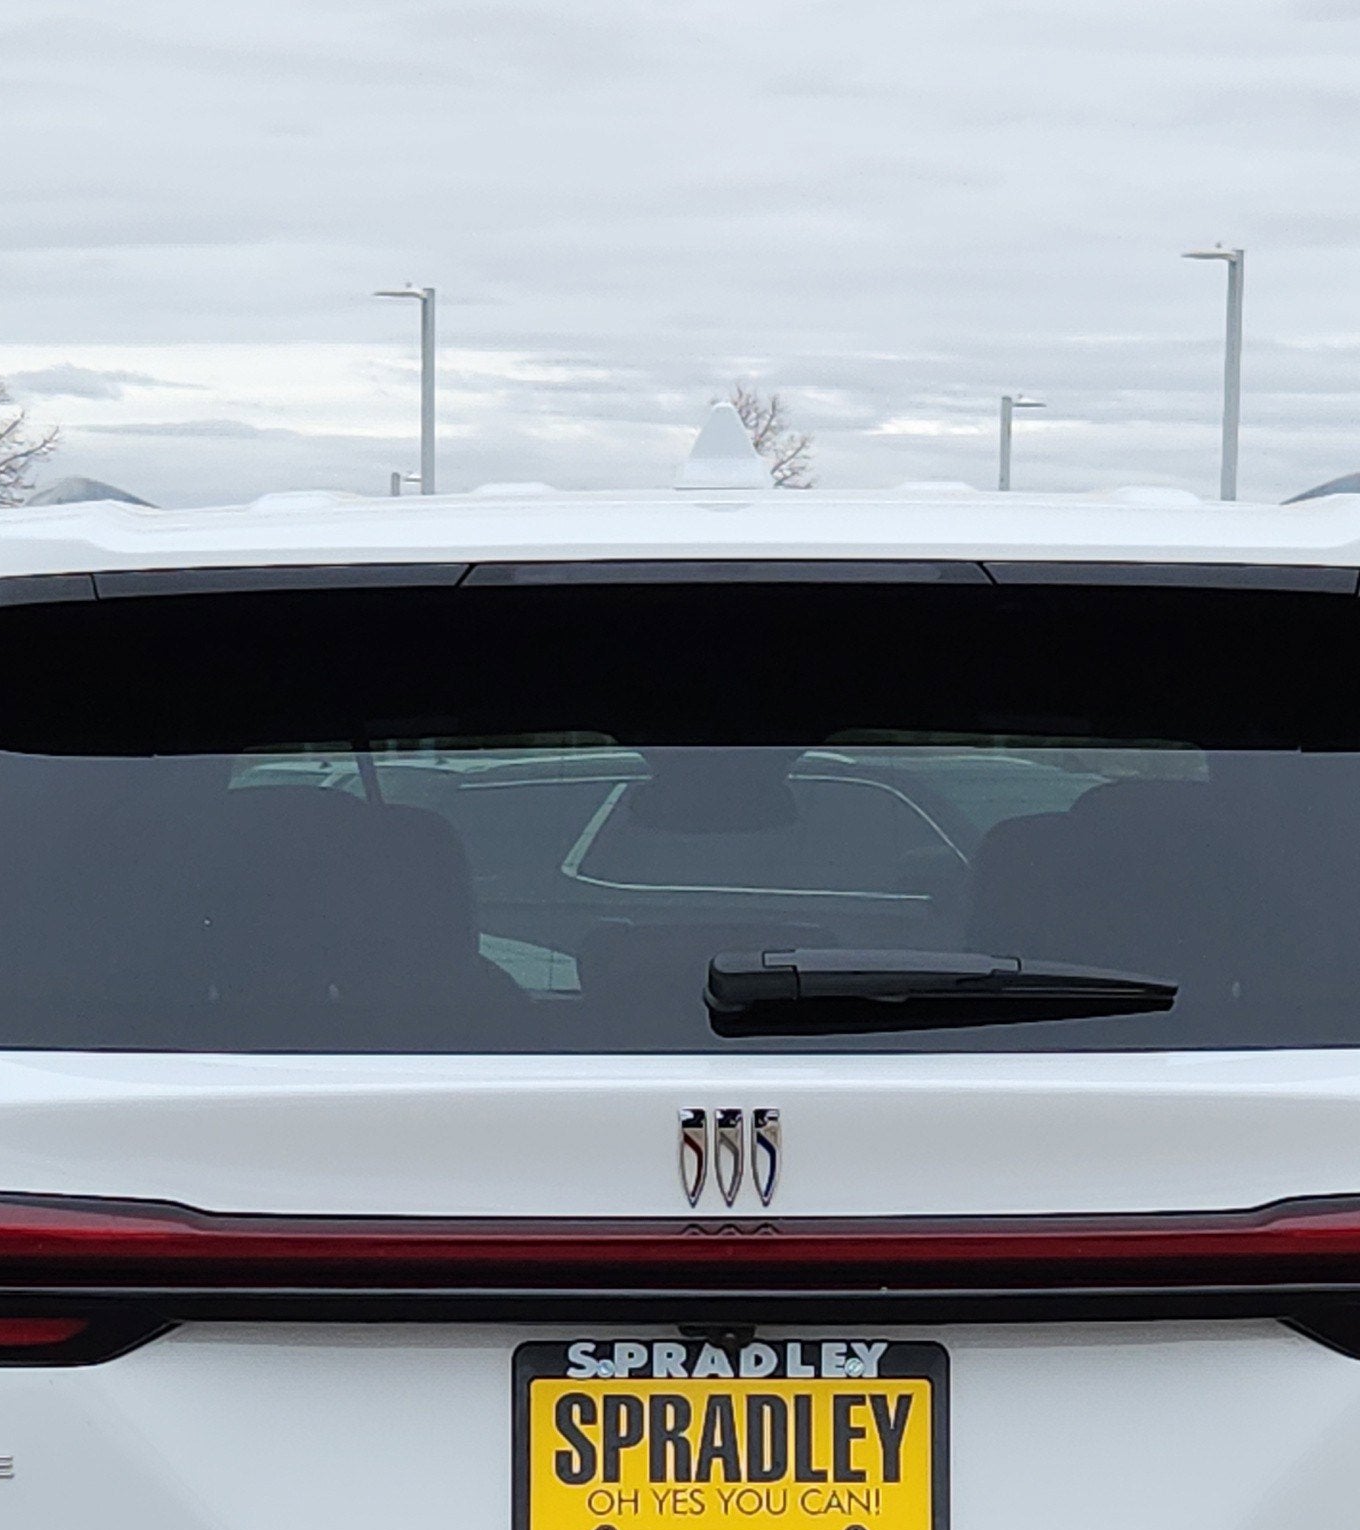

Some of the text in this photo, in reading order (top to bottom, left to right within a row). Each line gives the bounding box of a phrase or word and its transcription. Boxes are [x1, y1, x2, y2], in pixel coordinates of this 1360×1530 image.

[567, 1341, 888, 1379] SPRADLEY
[554, 1392, 914, 1484] SPRADLEY
[587, 1489, 882, 1516] OH YES YOU CAN!
